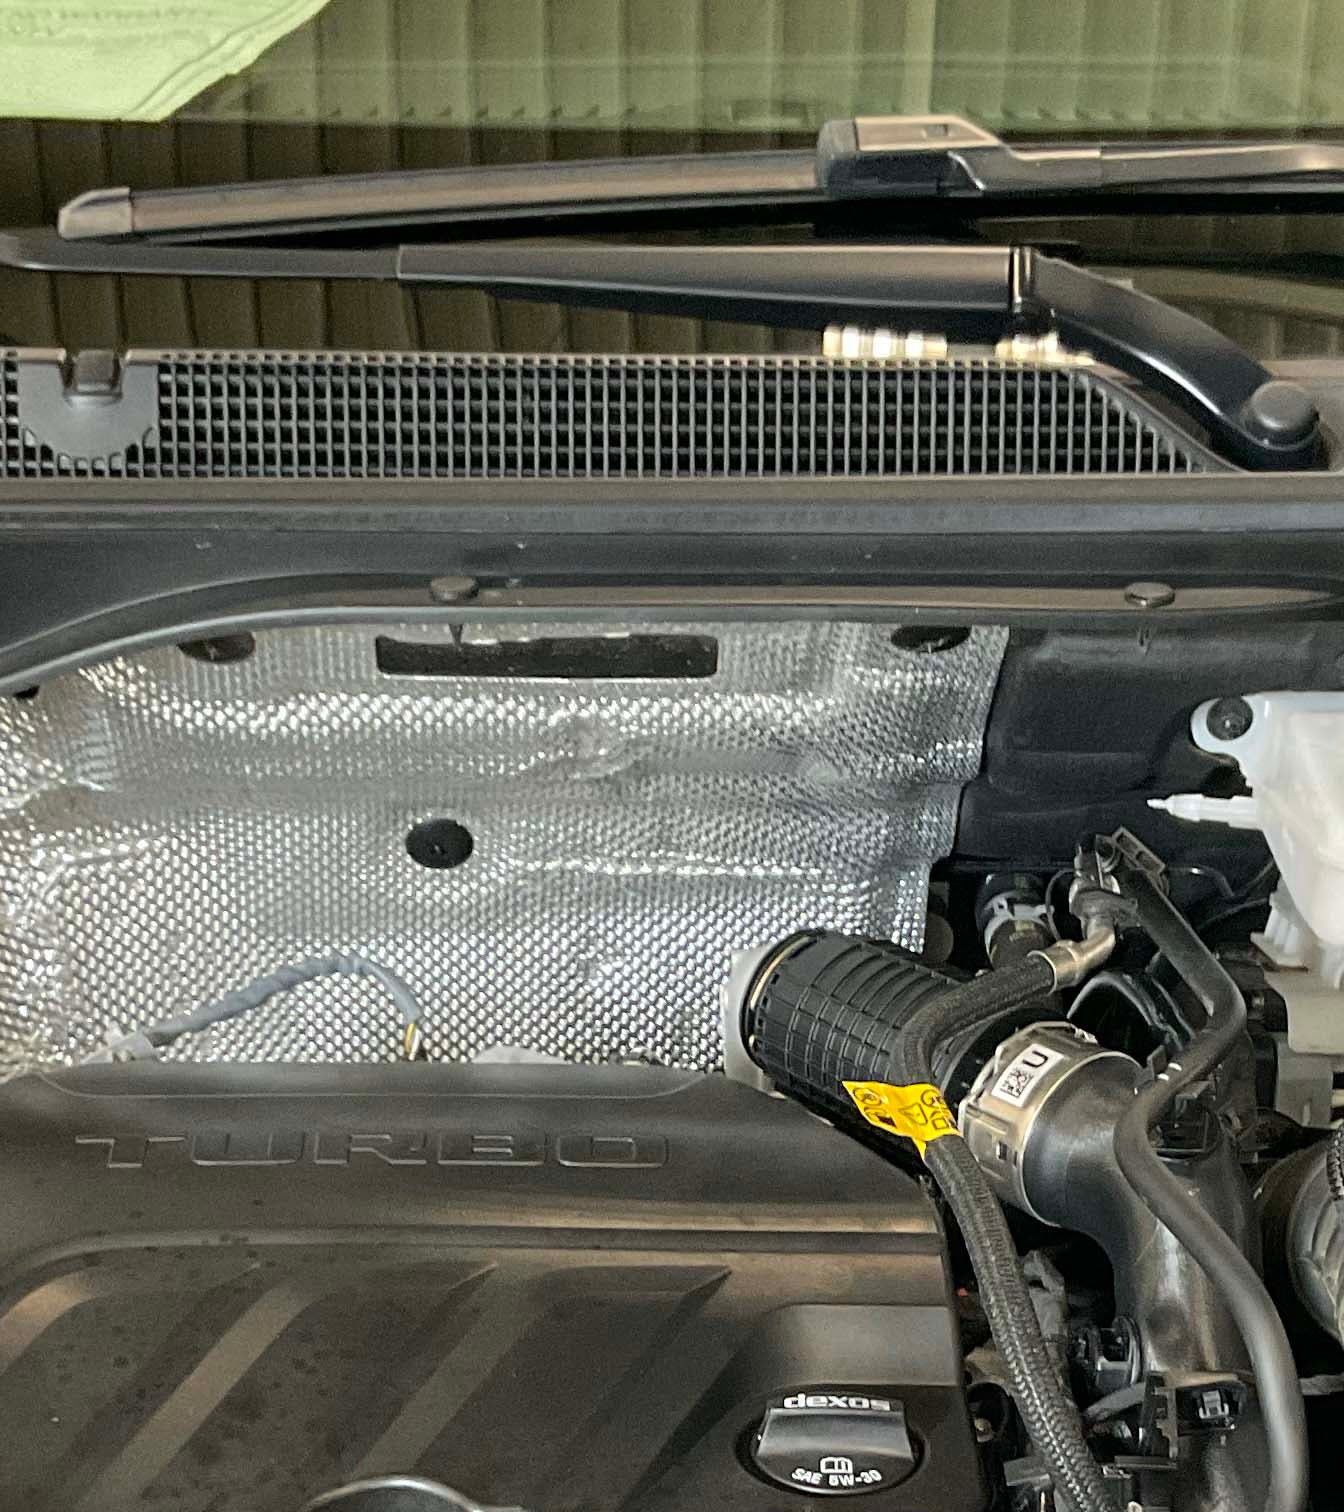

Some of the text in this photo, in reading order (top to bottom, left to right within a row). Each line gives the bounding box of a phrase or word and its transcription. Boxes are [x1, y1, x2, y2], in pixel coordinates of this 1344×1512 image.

[1022, 1050, 1049, 1068] U
[75, 1131, 670, 1171] TURBO
[783, 1393, 891, 1412] dexos
[791, 1467, 883, 1486] SAE 5W-30
